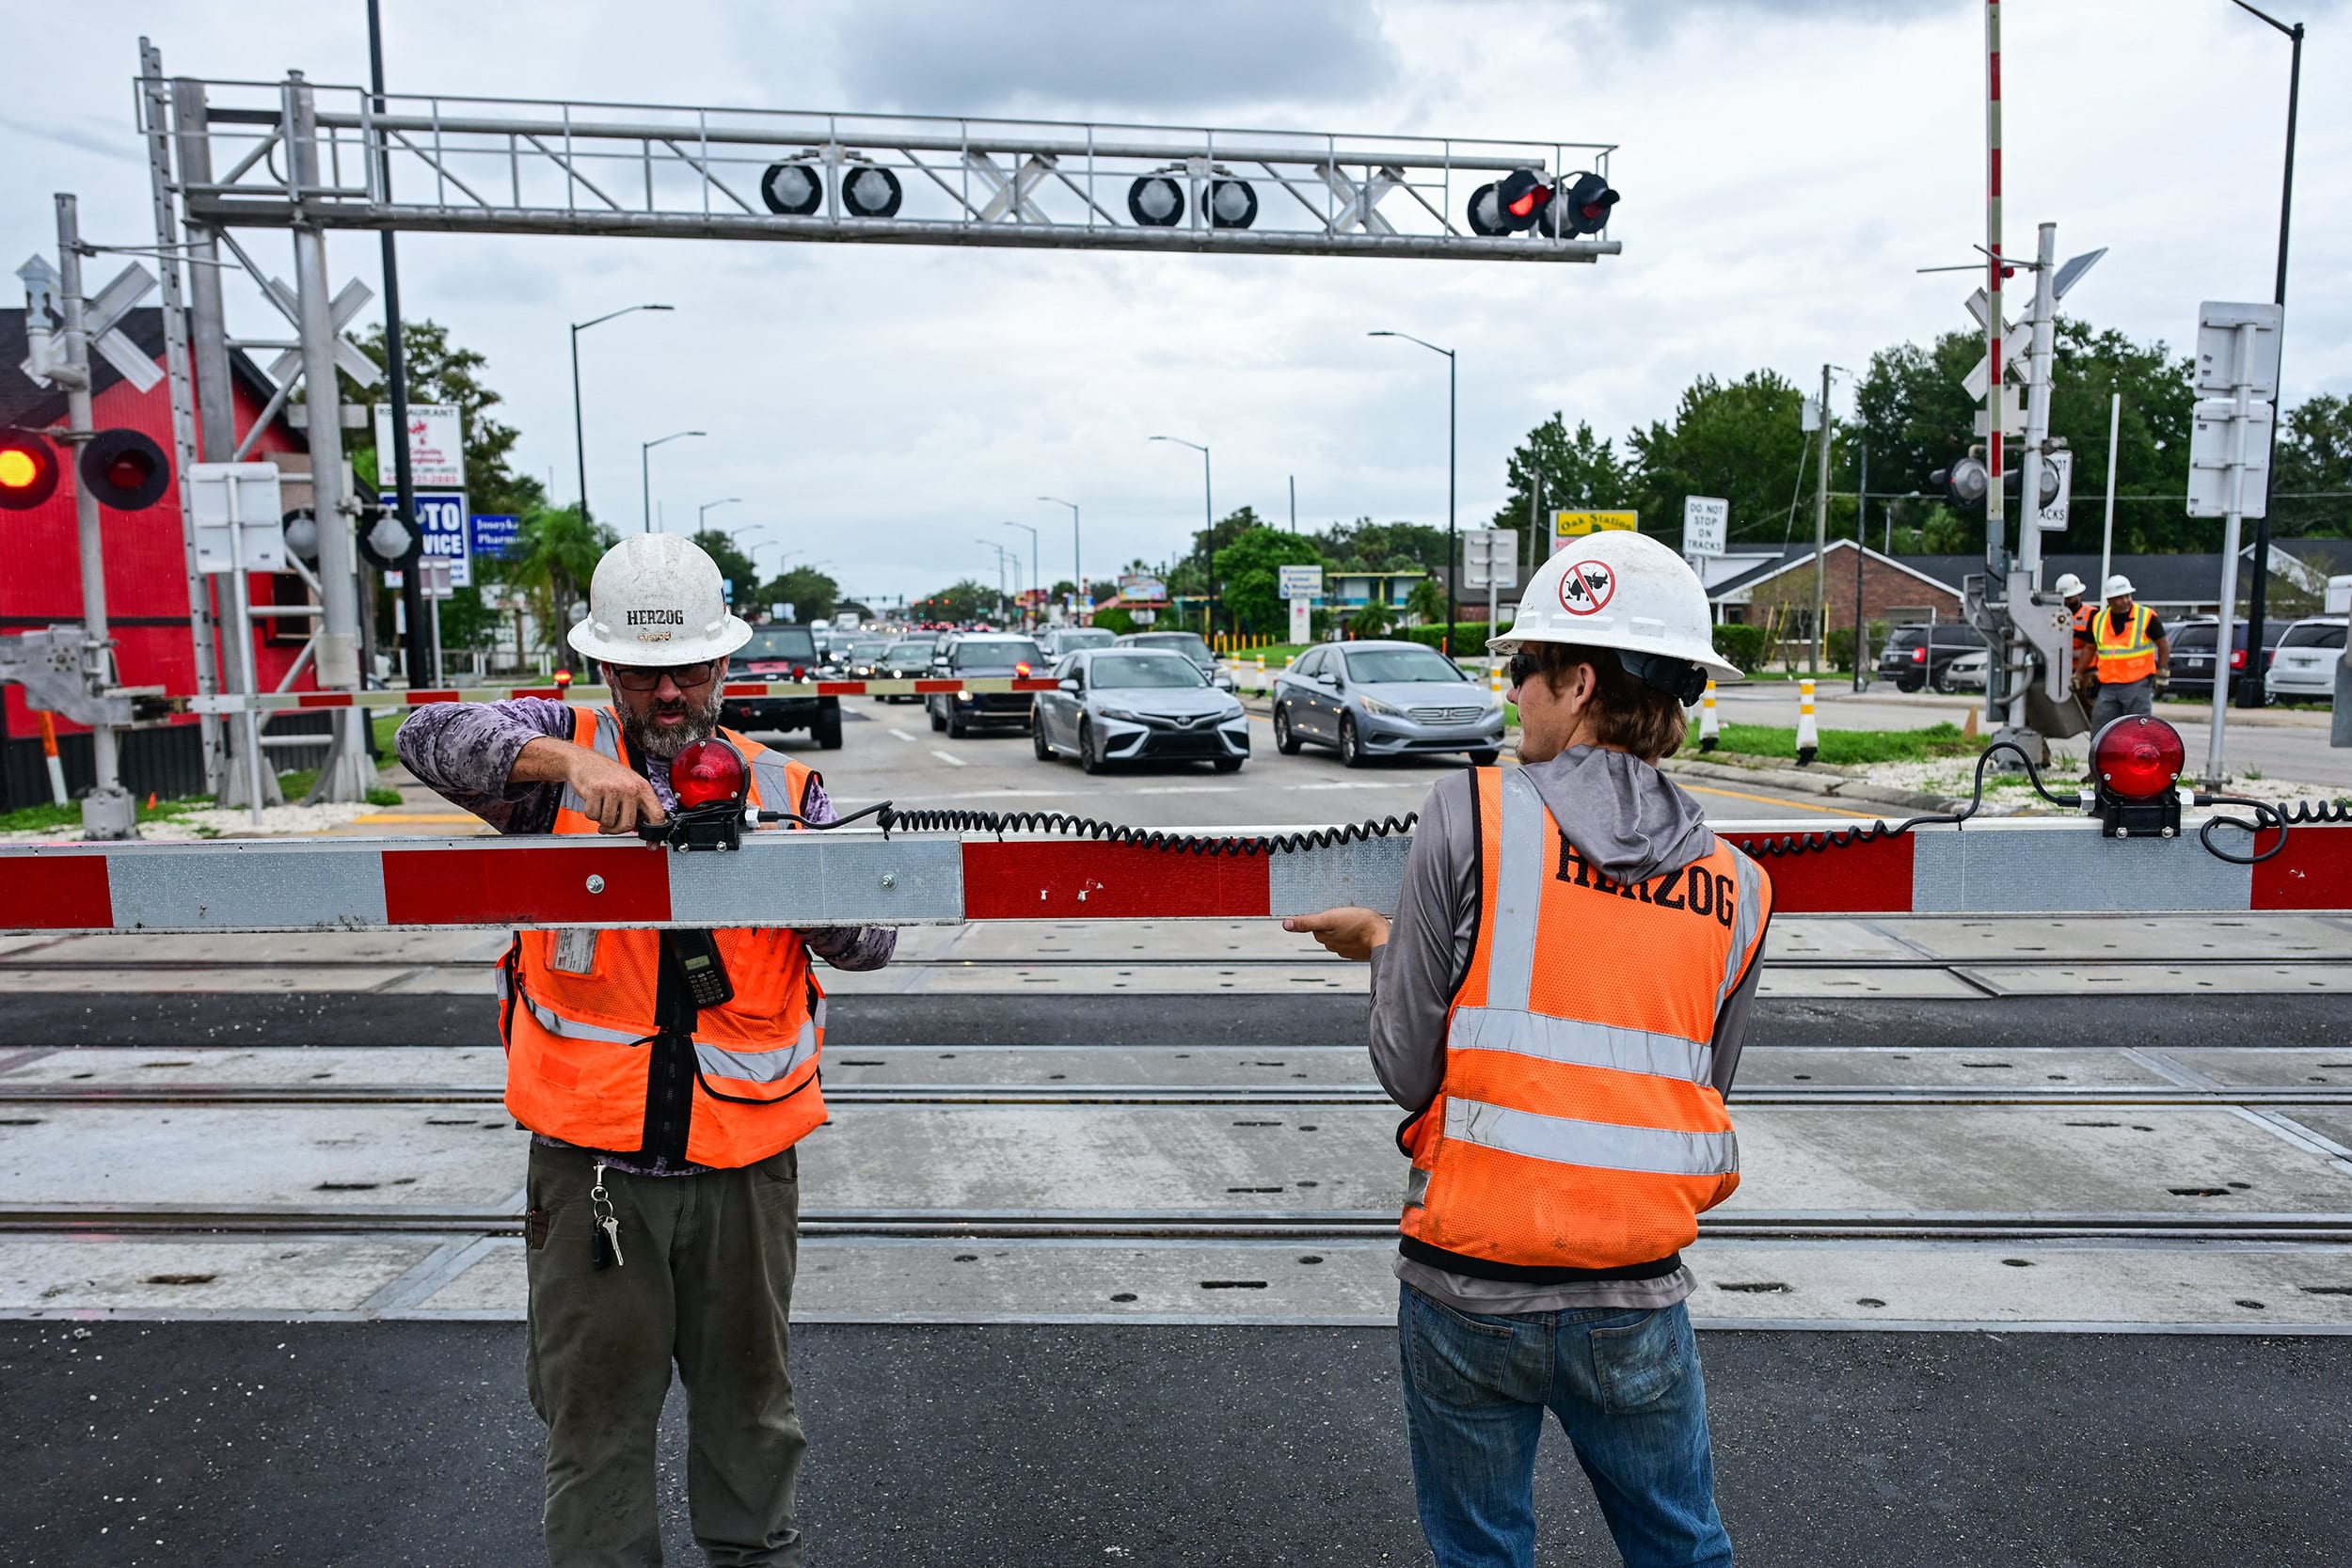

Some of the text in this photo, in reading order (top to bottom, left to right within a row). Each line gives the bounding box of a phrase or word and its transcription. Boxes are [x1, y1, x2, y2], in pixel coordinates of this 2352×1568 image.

[1690, 503, 1724, 515] DO NOT
[2039, 509, 2065, 521] ACKS
[424, 502, 461, 531] TO
[1562, 514, 1632, 531] Oak Station
[1694, 515, 1718, 526] STOP
[1698, 528, 1712, 537] ON
[422, 533, 463, 555] VICE
[1688, 539, 1722, 552] TRACKS
[627, 610, 684, 625] HERZOG
